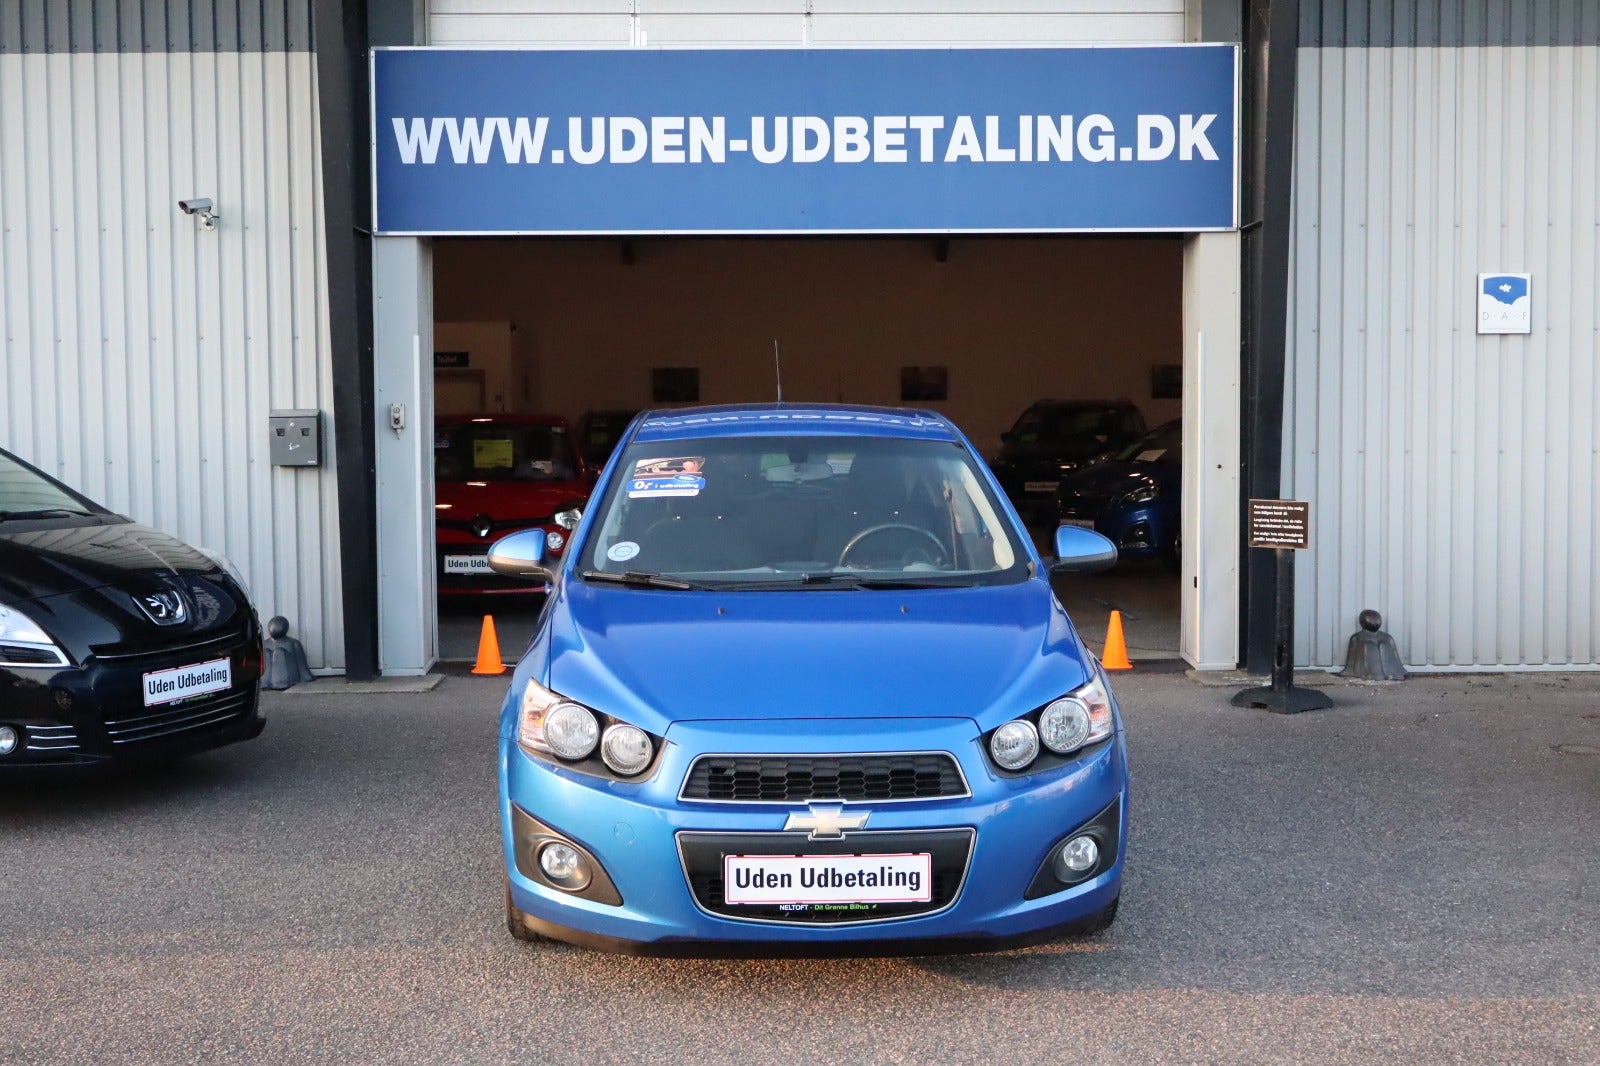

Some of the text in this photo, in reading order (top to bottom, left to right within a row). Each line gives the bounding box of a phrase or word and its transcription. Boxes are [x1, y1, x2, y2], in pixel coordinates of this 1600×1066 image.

[391, 113, 1219, 165] WWW.UDEN-UDBETALING.DK
[448, 560, 469, 568] Uden
[148, 668, 227, 695] Uden Udbetaling
[735, 866, 921, 891] Uden Udbetaling
